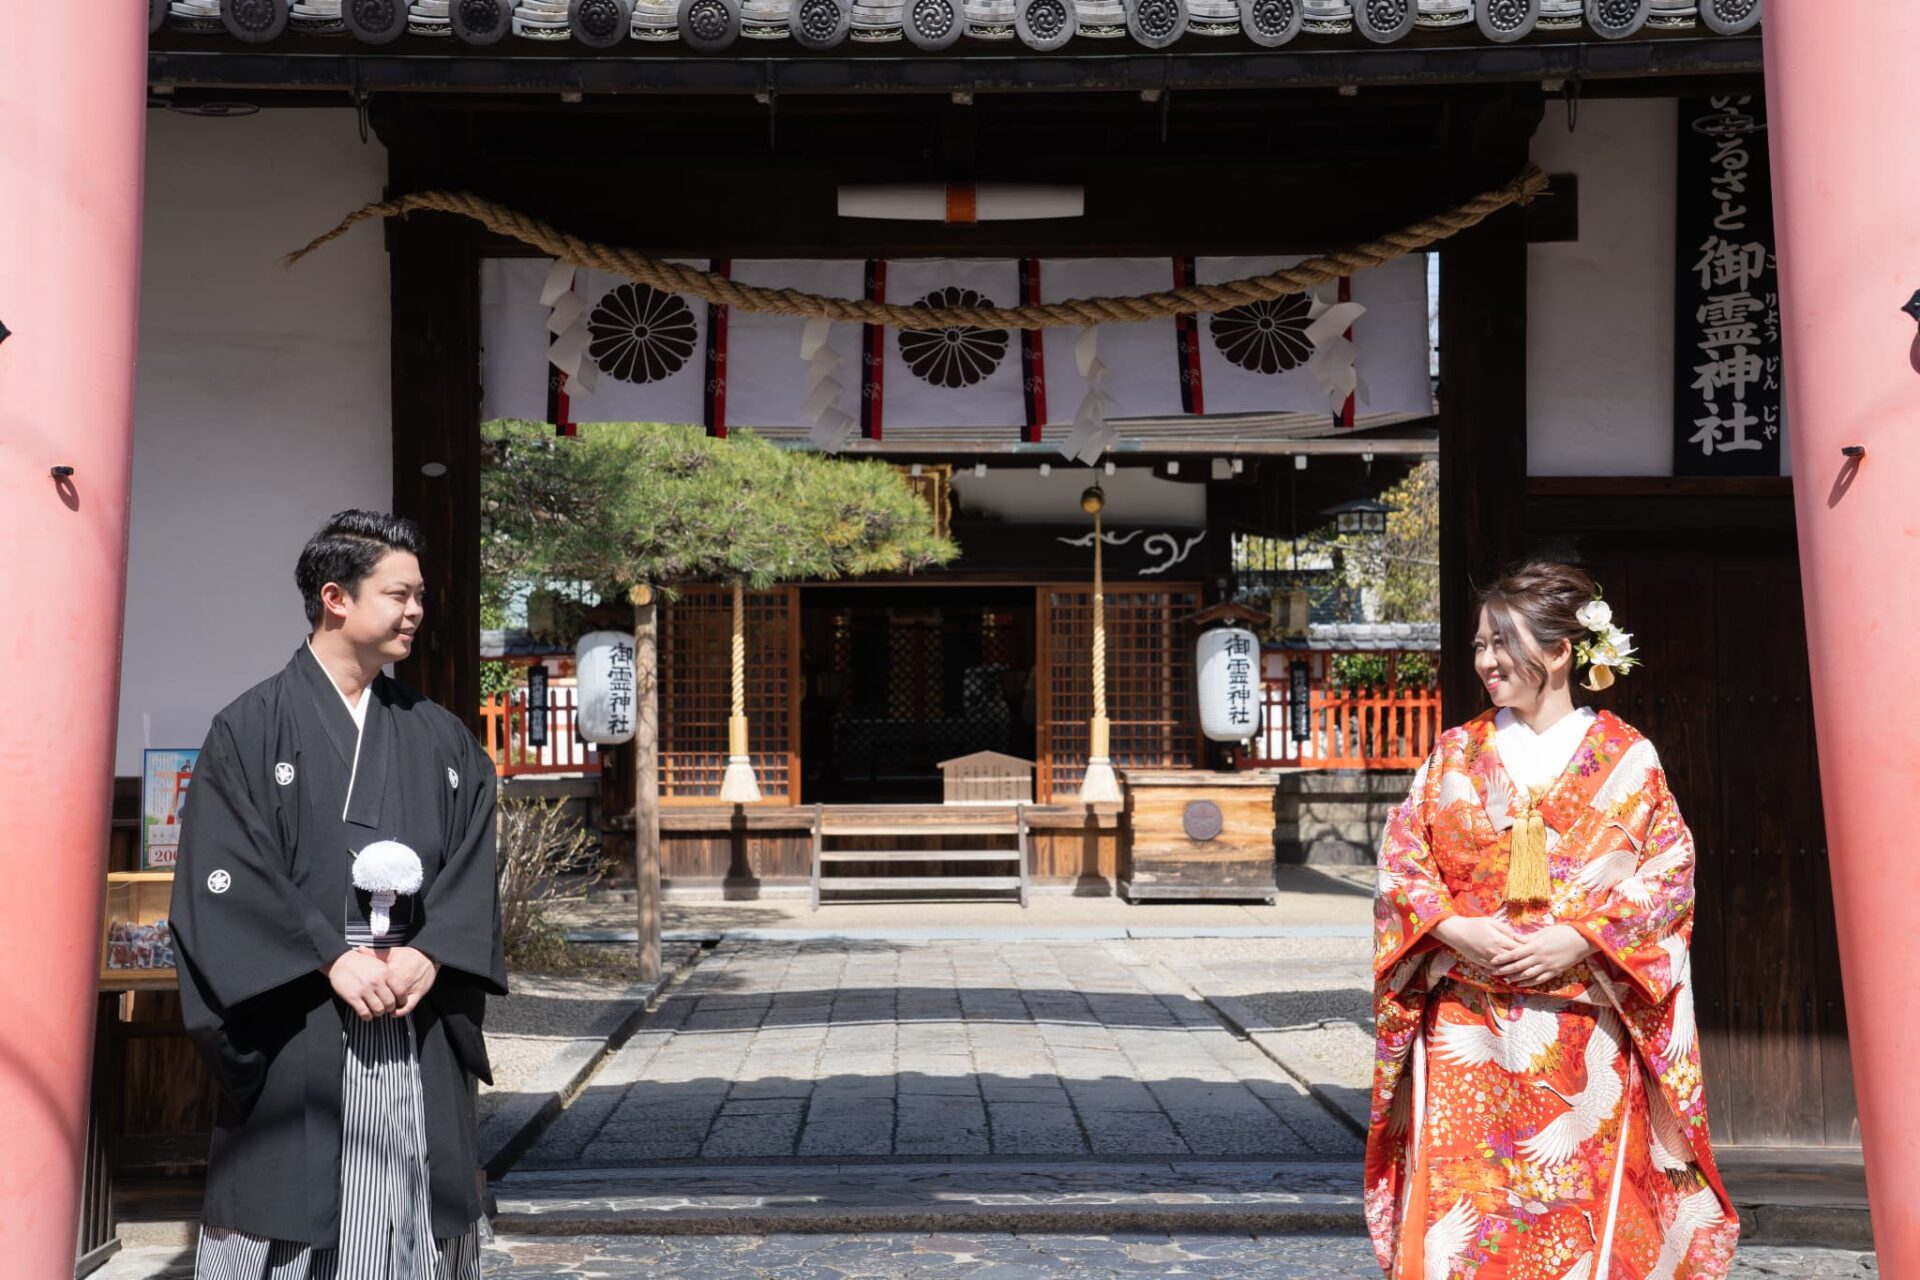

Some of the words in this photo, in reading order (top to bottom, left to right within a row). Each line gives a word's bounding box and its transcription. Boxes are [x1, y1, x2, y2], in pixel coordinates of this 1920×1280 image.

[607, 642, 633, 735] 御霊神社
[1223, 633, 1250, 725] 御霊神社
[154, 850, 178, 863] 20
